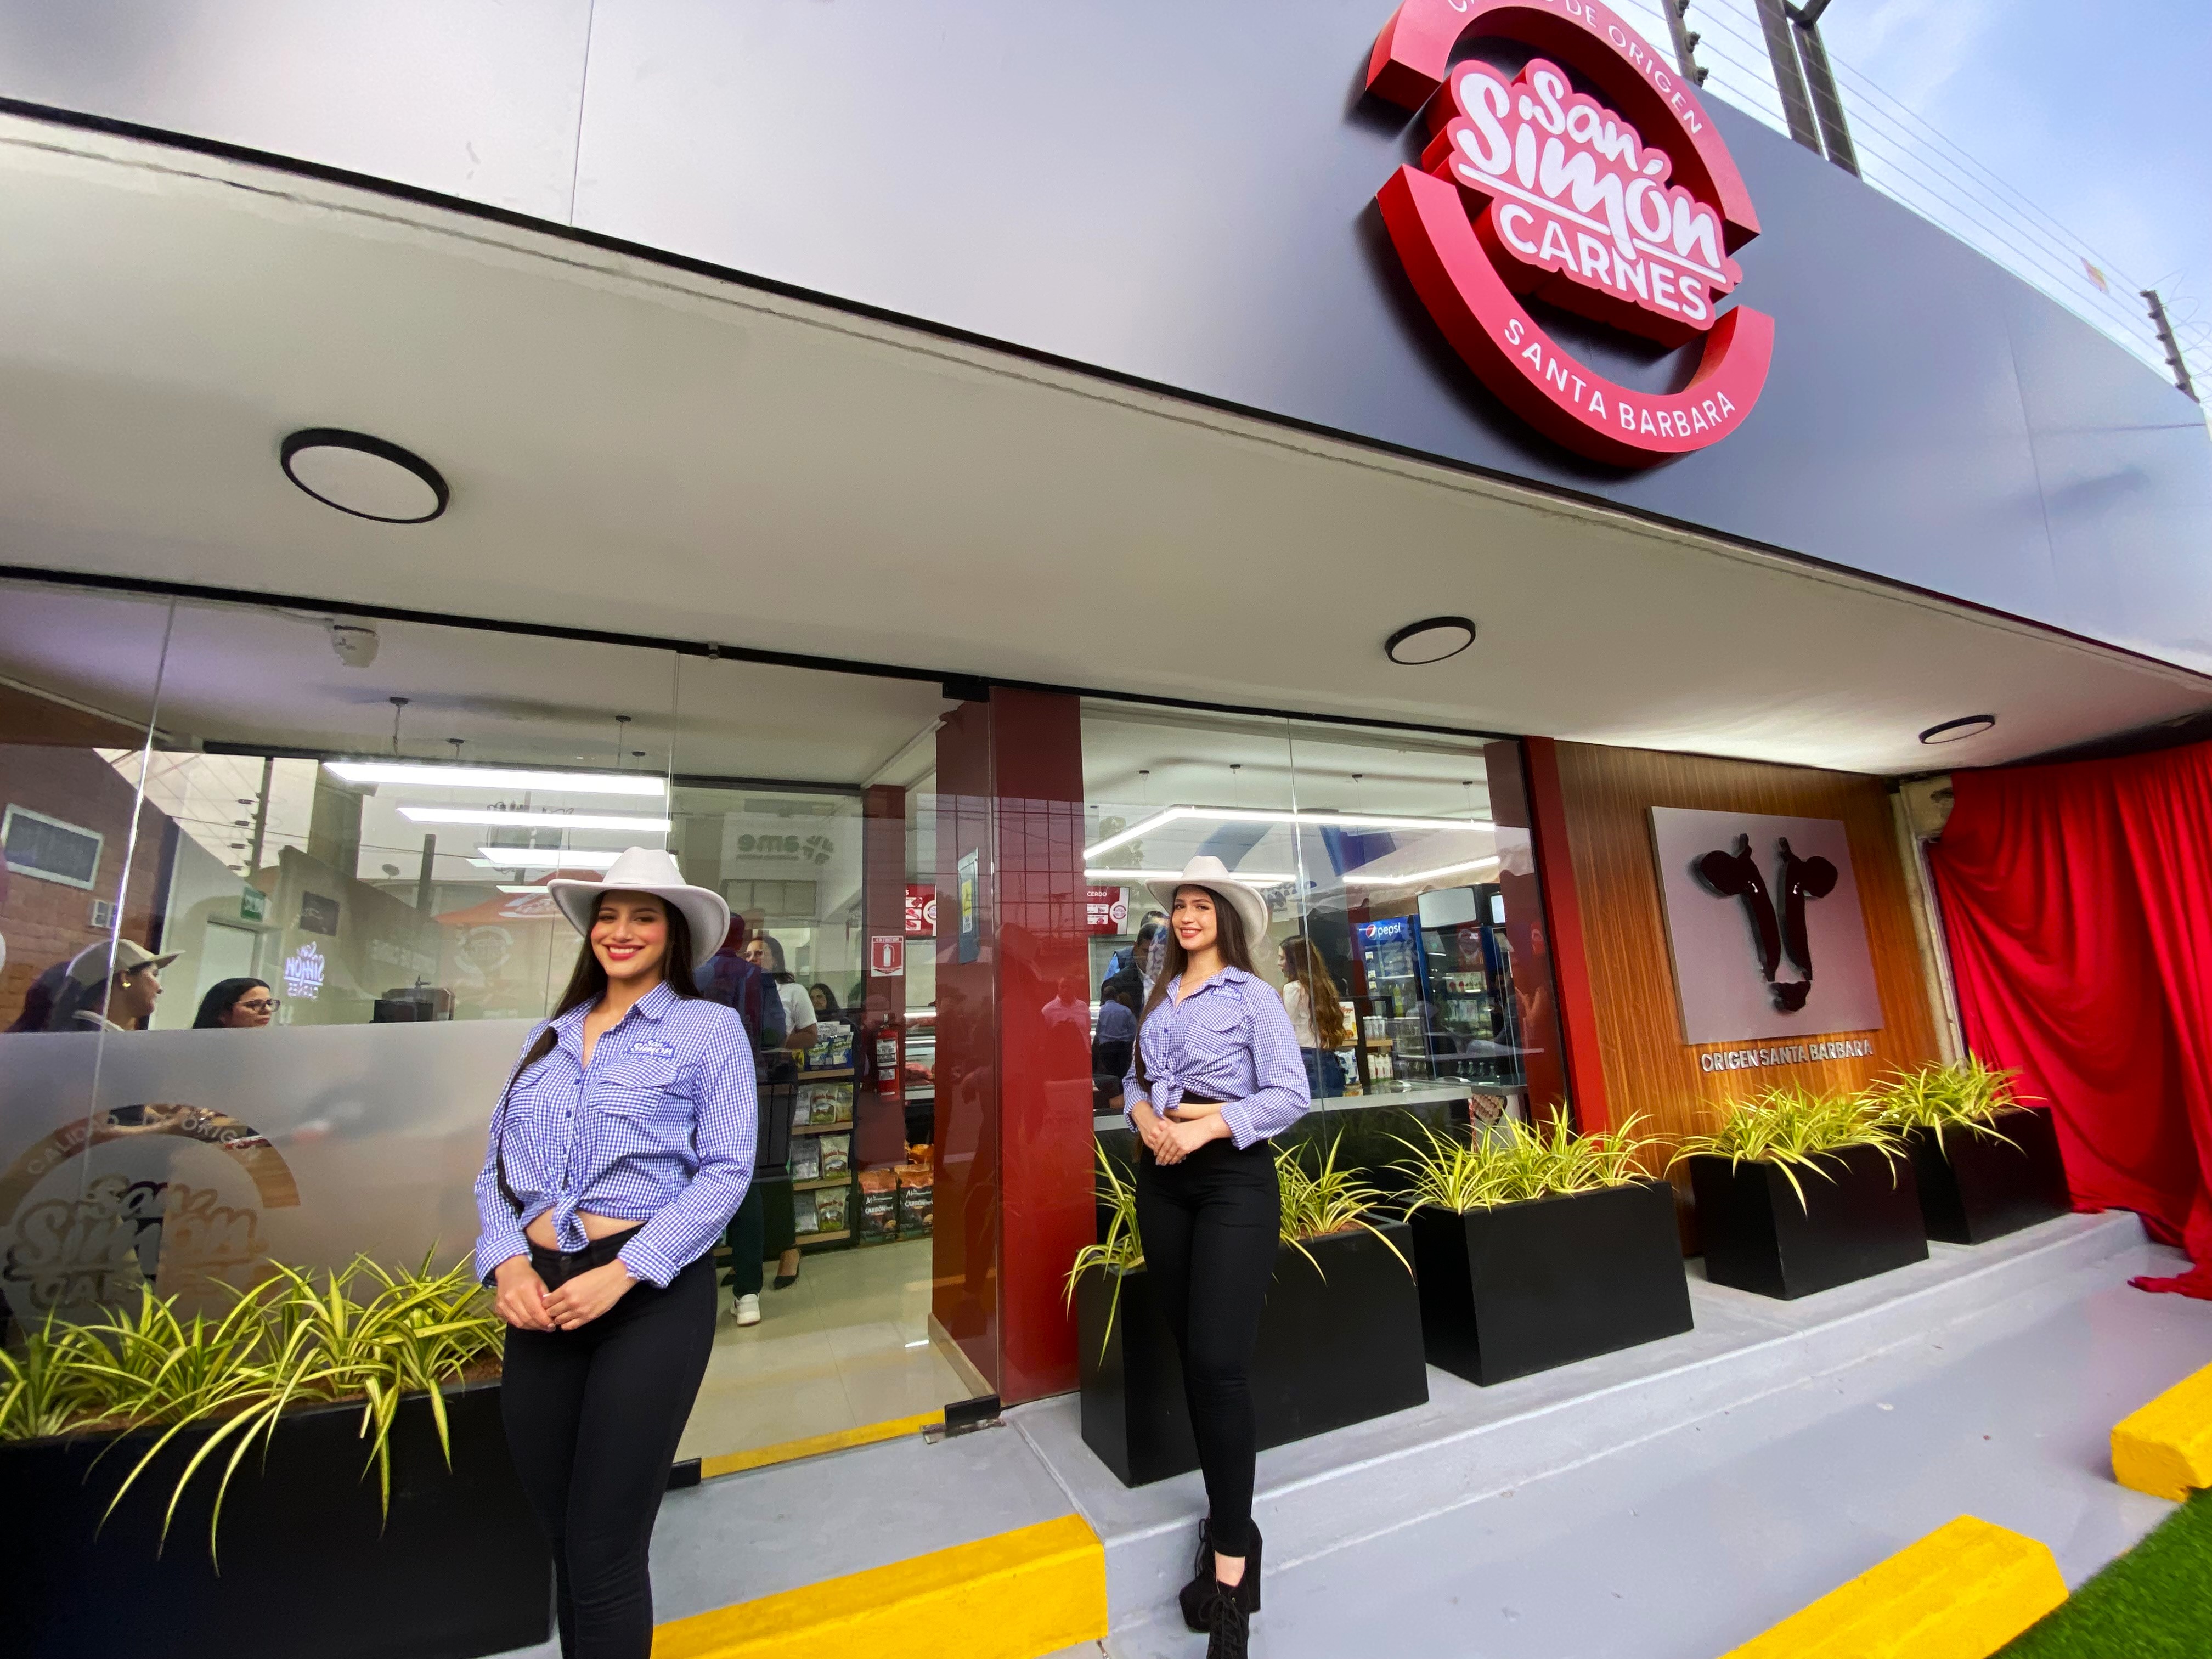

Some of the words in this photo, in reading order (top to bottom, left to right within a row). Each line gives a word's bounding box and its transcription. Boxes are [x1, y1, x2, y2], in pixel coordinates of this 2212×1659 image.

[1518, 70, 1638, 172] San
[1608, 25, 1703, 134] ORIGEN
[1457, 73, 1722, 268] Simón
[1499, 203, 1708, 321] CARNES
[1504, 318, 1608, 420] SANTA
[1620, 391, 1736, 438] BARBARA
[1377, 922, 1401, 938] pepsi
[1701, 1049, 1759, 1072] ORIGEN
[1760, 1045, 1808, 1066] SANTA
[1809, 1039, 1874, 1061] BARBARA
